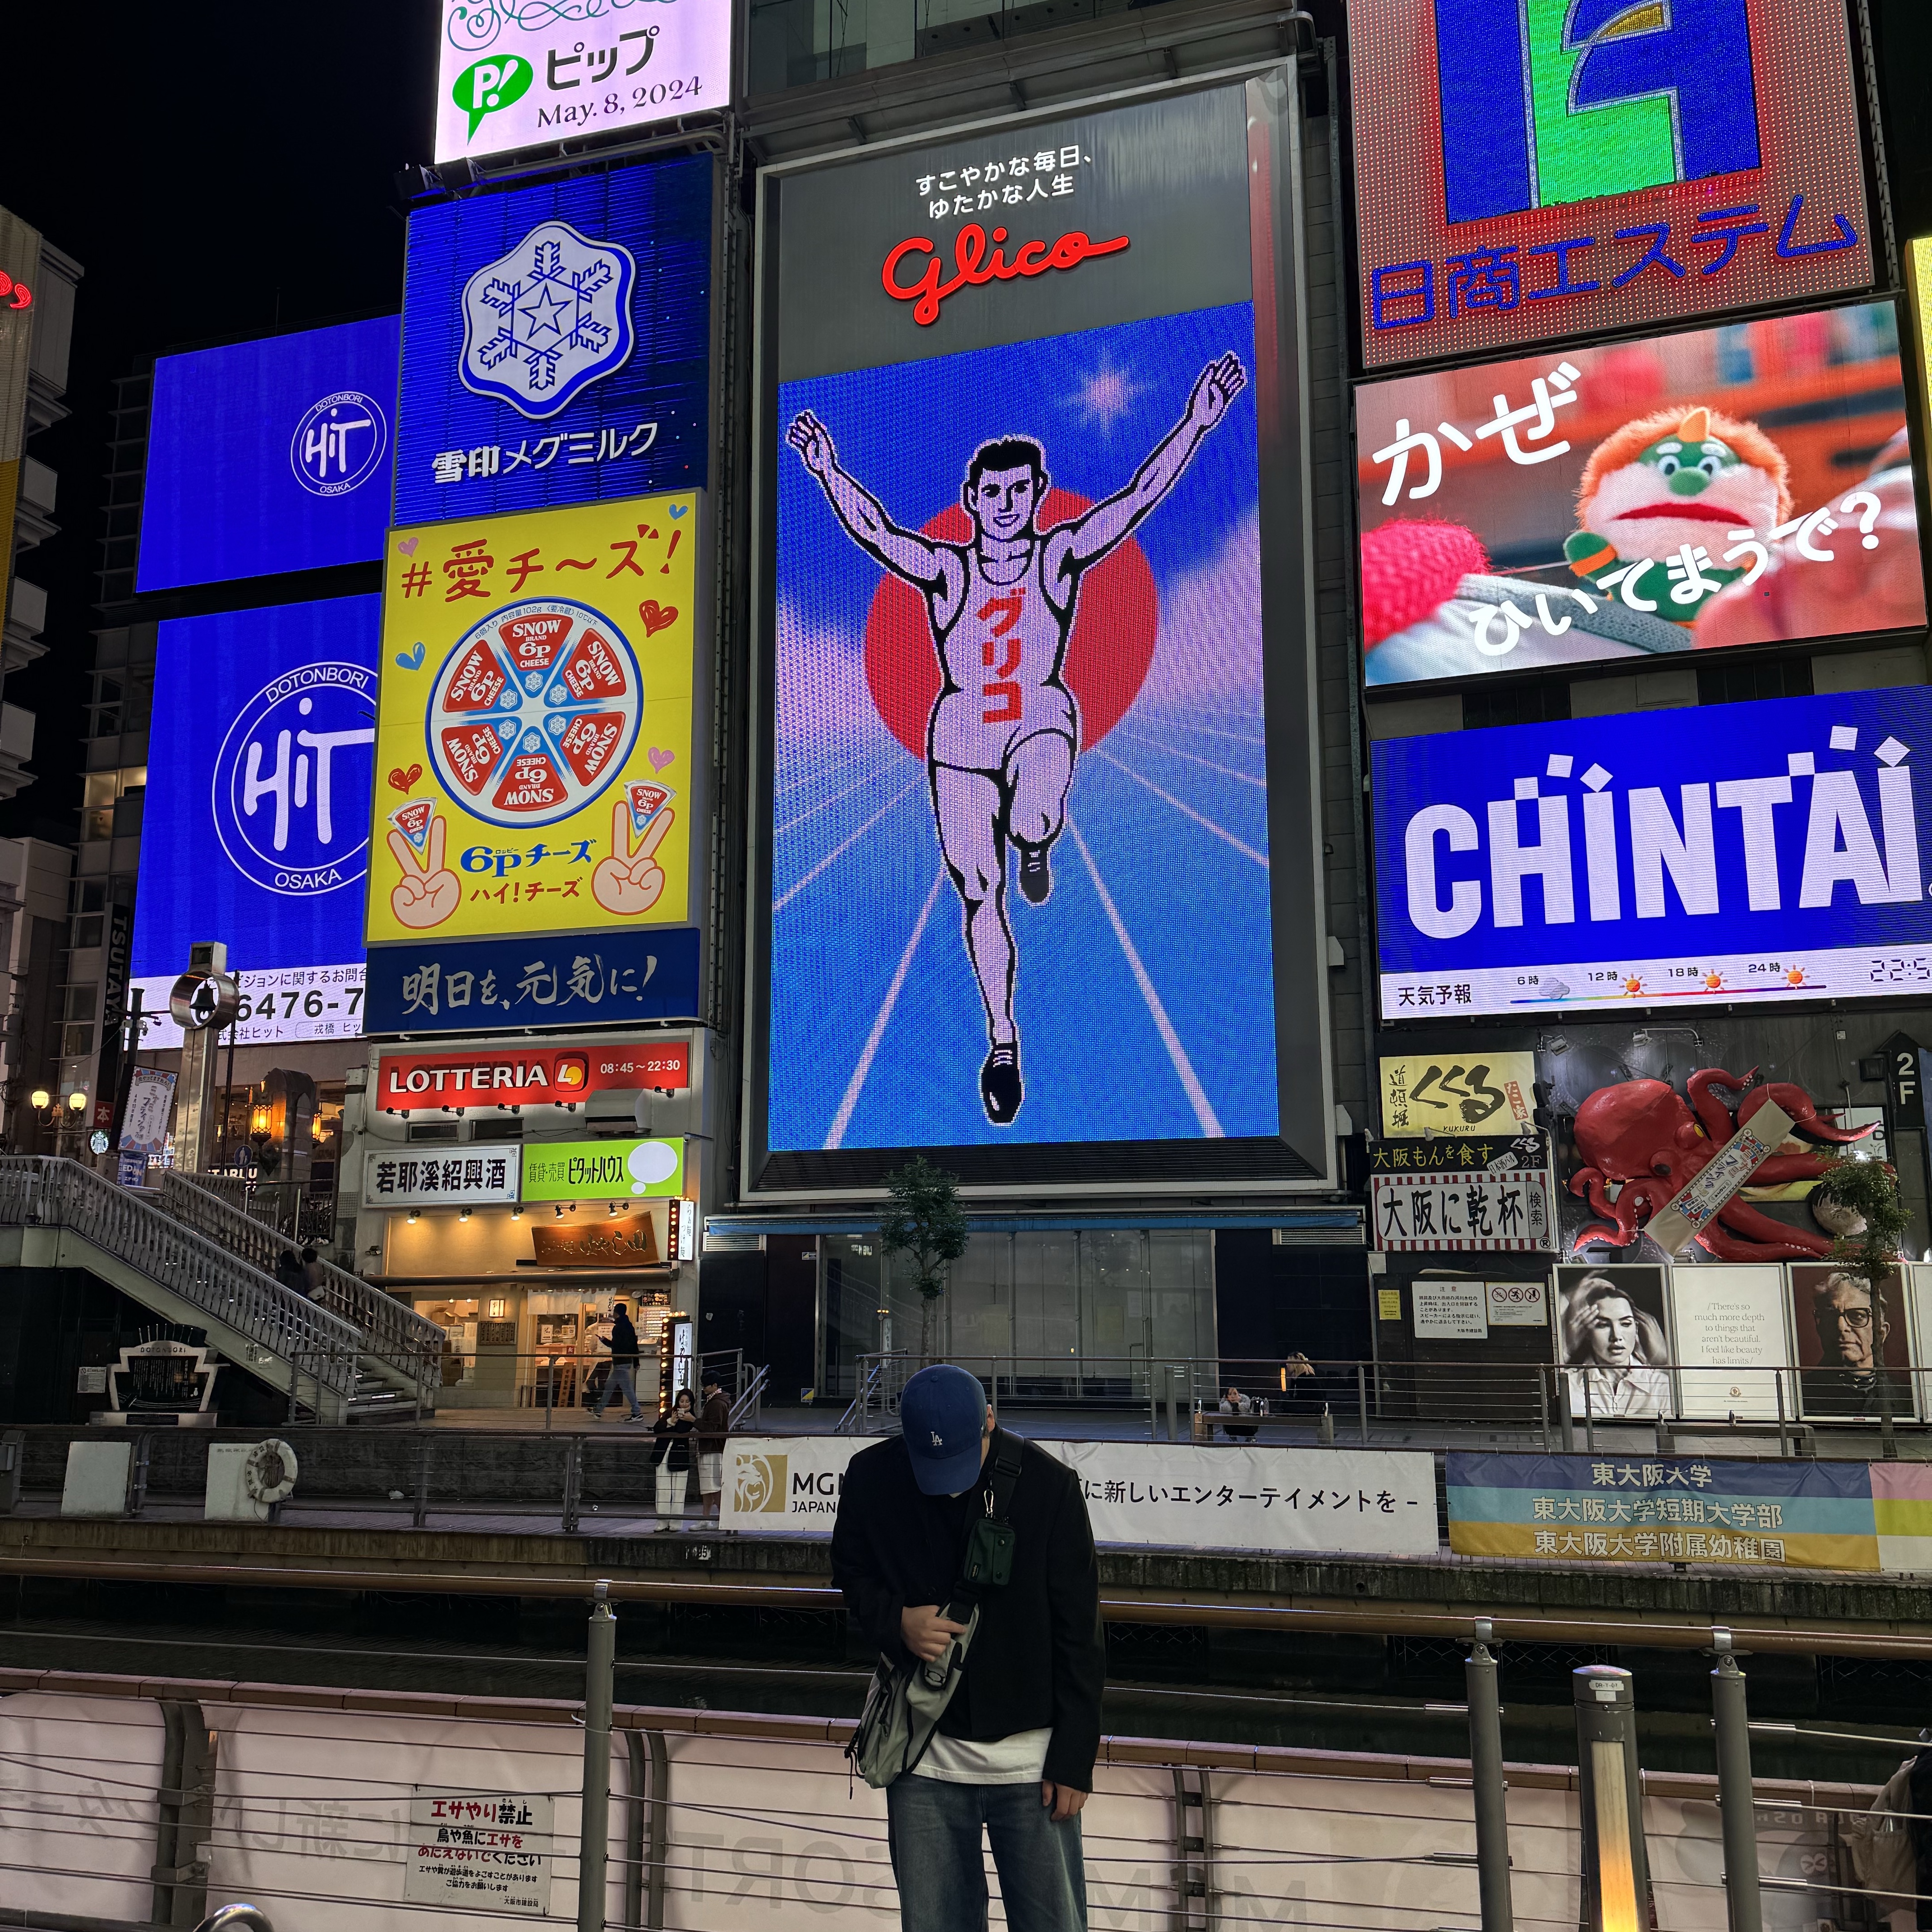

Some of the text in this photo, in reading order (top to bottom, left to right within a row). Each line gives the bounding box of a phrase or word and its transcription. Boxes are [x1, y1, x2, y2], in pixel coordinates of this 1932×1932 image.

[547, 25, 660, 90] ピップ
[538, 76, 702, 128] May. 8, 2024
[916, 144, 1091, 196] すこやかな毎日、
[929, 173, 1074, 219] ゆたかな人生
[882, 223, 1129, 325] Glico
[1371, 194, 1858, 330] 日商エステム
[315, 394, 363, 412] DOTONBORI
[1372, 361, 1581, 506] かぜ
[432, 423, 657, 483] 雪印メグミルク
[319, 482, 351, 494] OSAKA
[1469, 491, 1881, 656] ひいてまうで?
[475, 620, 498, 639] 6個入り
[512, 619, 562, 637] SNOW
[520, 658, 549, 668] CHEESE
[587, 640, 621, 686] SNOW
[977, 587, 1026, 724] グリコ
[450, 650, 484, 701] SNOW
[468, 669, 482, 691] BRAND
[588, 659, 603, 680] BRAND
[265, 667, 369, 703] DOTONBORI
[484, 676, 504, 706] CHEESE
[564, 669, 584, 698] CHEESE
[483, 726, 501, 755] CHEESE
[562, 718, 583, 749] CHEESE
[585, 733, 600, 755] BRAND
[446, 738, 479, 785] SNOW
[464, 744, 478, 764] BRAND
[516, 756, 546, 767] CHEESE
[586, 723, 618, 777] SNOW
[504, 787, 555, 806] SNOW
[636, 789, 662, 799] SNOW
[402, 805, 425, 820] SNOW
[275, 869, 342, 890] OSAKA
[470, 876, 584, 905] ハイ!チーズ
[402, 953, 658, 1014] 明日を、元気に!
[1517, 961, 1780, 986] 6時 12時 18時 24時
[1398, 984, 1472, 1006] 天気予報
[314, 1023, 335, 1035] 戎橋
[390, 1065, 548, 1093] LOTTERIA
[1389, 1065, 1409, 1128] 道頓堀
[1409, 1064, 1505, 1124] くくる
[1505, 1082, 1529, 1120] たこ家
[97, 1107, 110, 1123] 本
[1373, 1143, 1493, 1168] 大阪もんを食す
[1510, 1137, 1541, 1153] くくる
[529, 1156, 625, 1185] 賃貸・売買 ピタットハウス
[1489, 1154, 1516, 1174] 日本酒バル
[1521, 1156, 1541, 1168] 2F
[1383, 1184, 1523, 1237] 大阪に乾杯
[1529, 1191, 1543, 1226] 検索
[1715, 1324, 1739, 1334] things
[1742, 1313, 1765, 1323] depth
[1736, 1346, 1762, 1355] beauty
[930, 1431, 943, 1446] LA
[1591, 1462, 1712, 1487] 東大阪大学
[792, 1501, 836, 1513] JAPAN
[1078, 1479, 1395, 1513] に新しいエンターテイメントを
[1532, 1496, 1783, 1530] 東大阪大学短期大学部
[1533, 1530, 1787, 1564] 東大阪大学附属幼稚園
[431, 1800, 533, 1826] エサやり禁止
[437, 1826, 523, 1849] 鳥や魚にエサを
[446, 1879, 509, 1892] ご協力をお願いします
